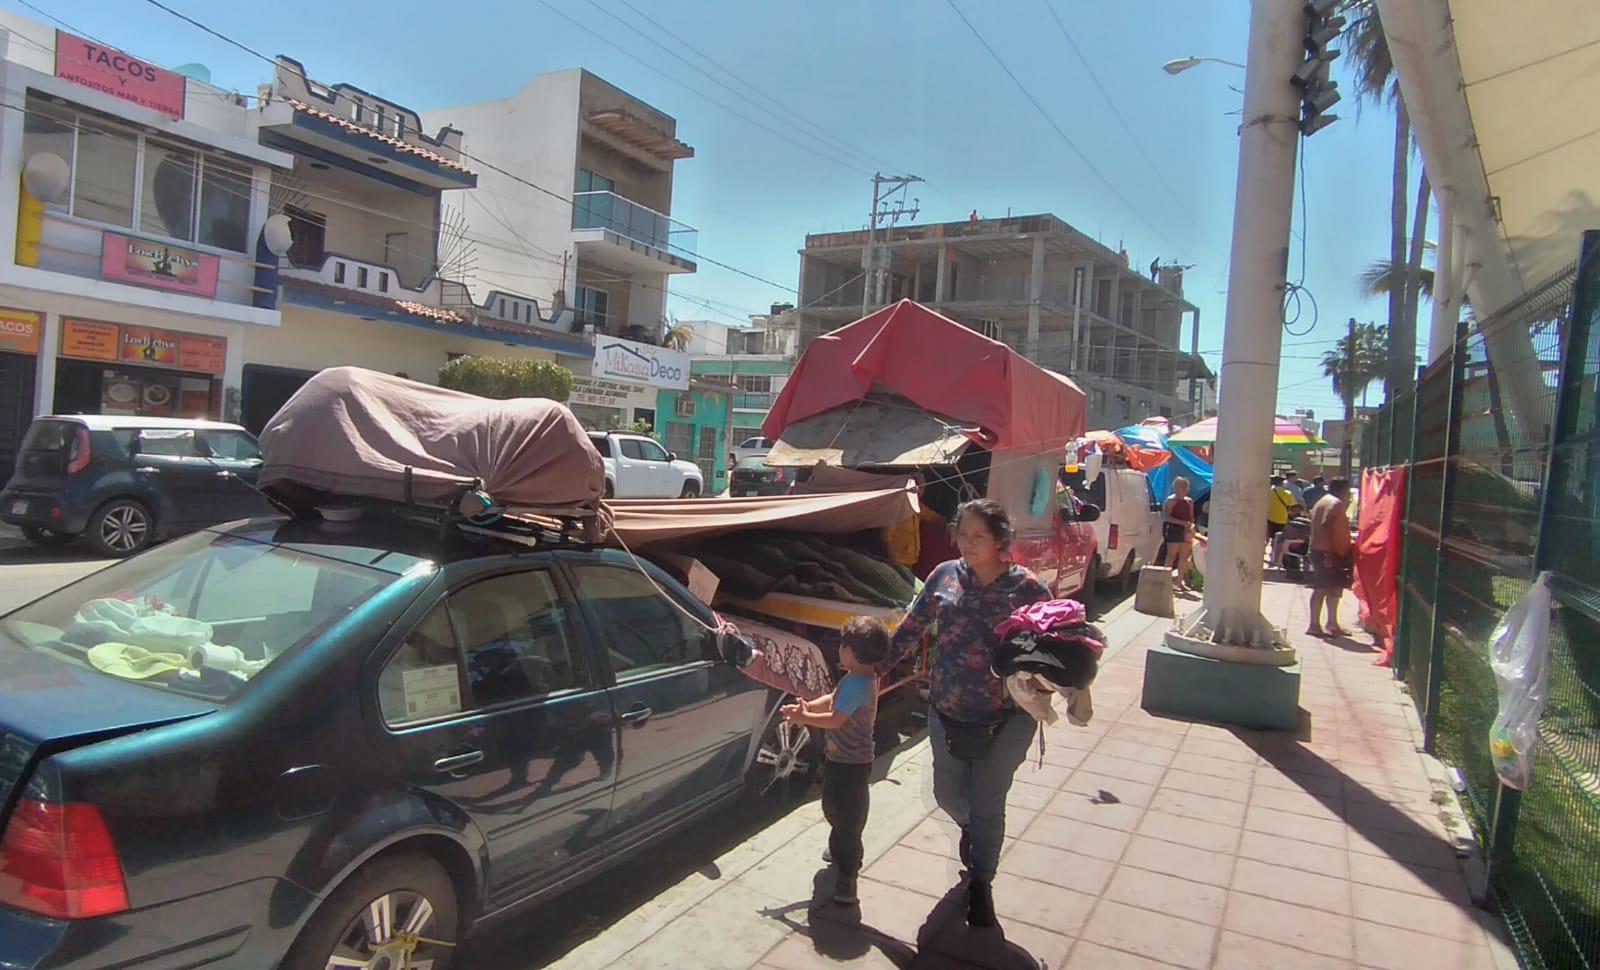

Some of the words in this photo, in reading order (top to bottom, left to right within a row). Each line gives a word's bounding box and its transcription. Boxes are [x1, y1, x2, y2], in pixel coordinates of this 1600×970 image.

[83, 43, 156, 82] TACOS
[59, 72, 115, 95] ANTOJITOS
[116, 90, 138, 103] MAR
[118, 76, 127, 87] Y
[650, 356, 681, 381] Deco
